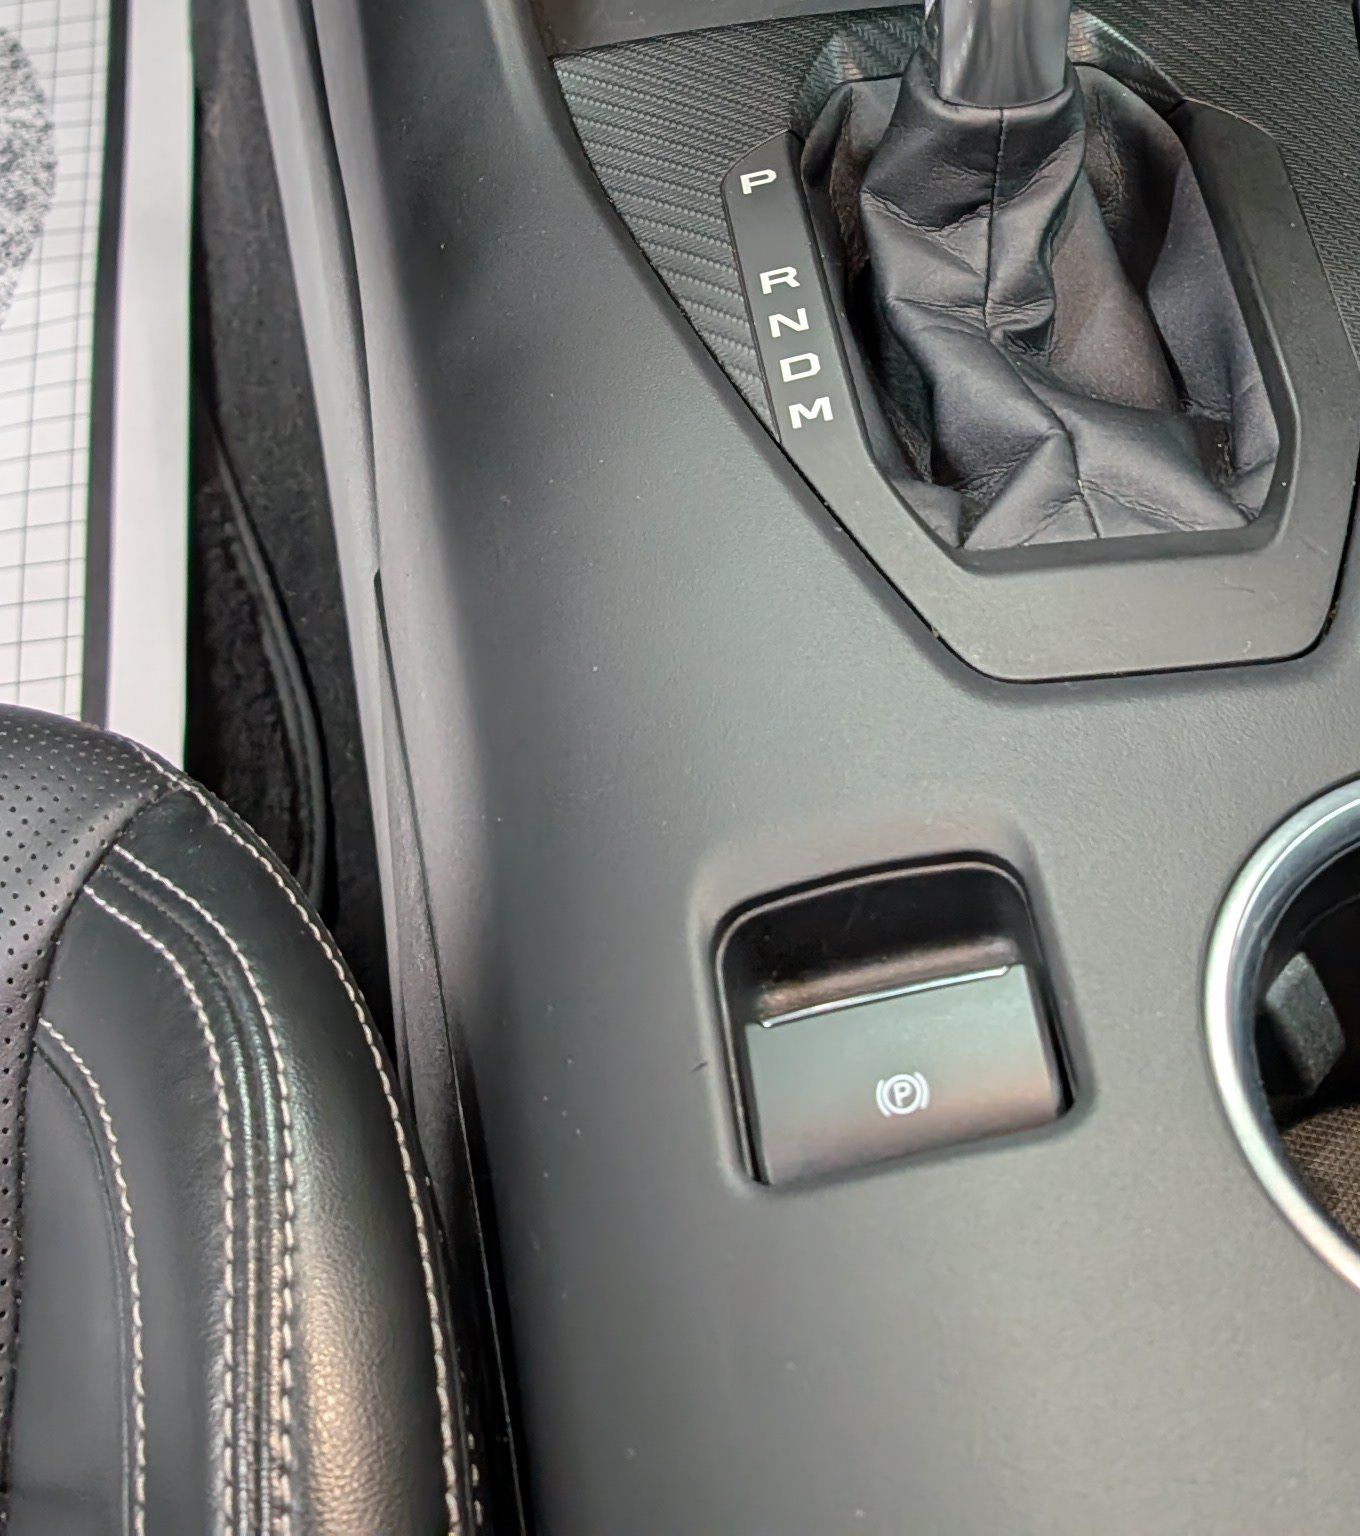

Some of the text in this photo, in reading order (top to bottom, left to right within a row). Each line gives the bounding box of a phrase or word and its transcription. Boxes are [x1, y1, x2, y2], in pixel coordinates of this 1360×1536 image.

[740, 169, 777, 195] P
[760, 266, 800, 295] R
[768, 308, 809, 338] N
[779, 352, 821, 383] D
[789, 396, 834, 429] M
